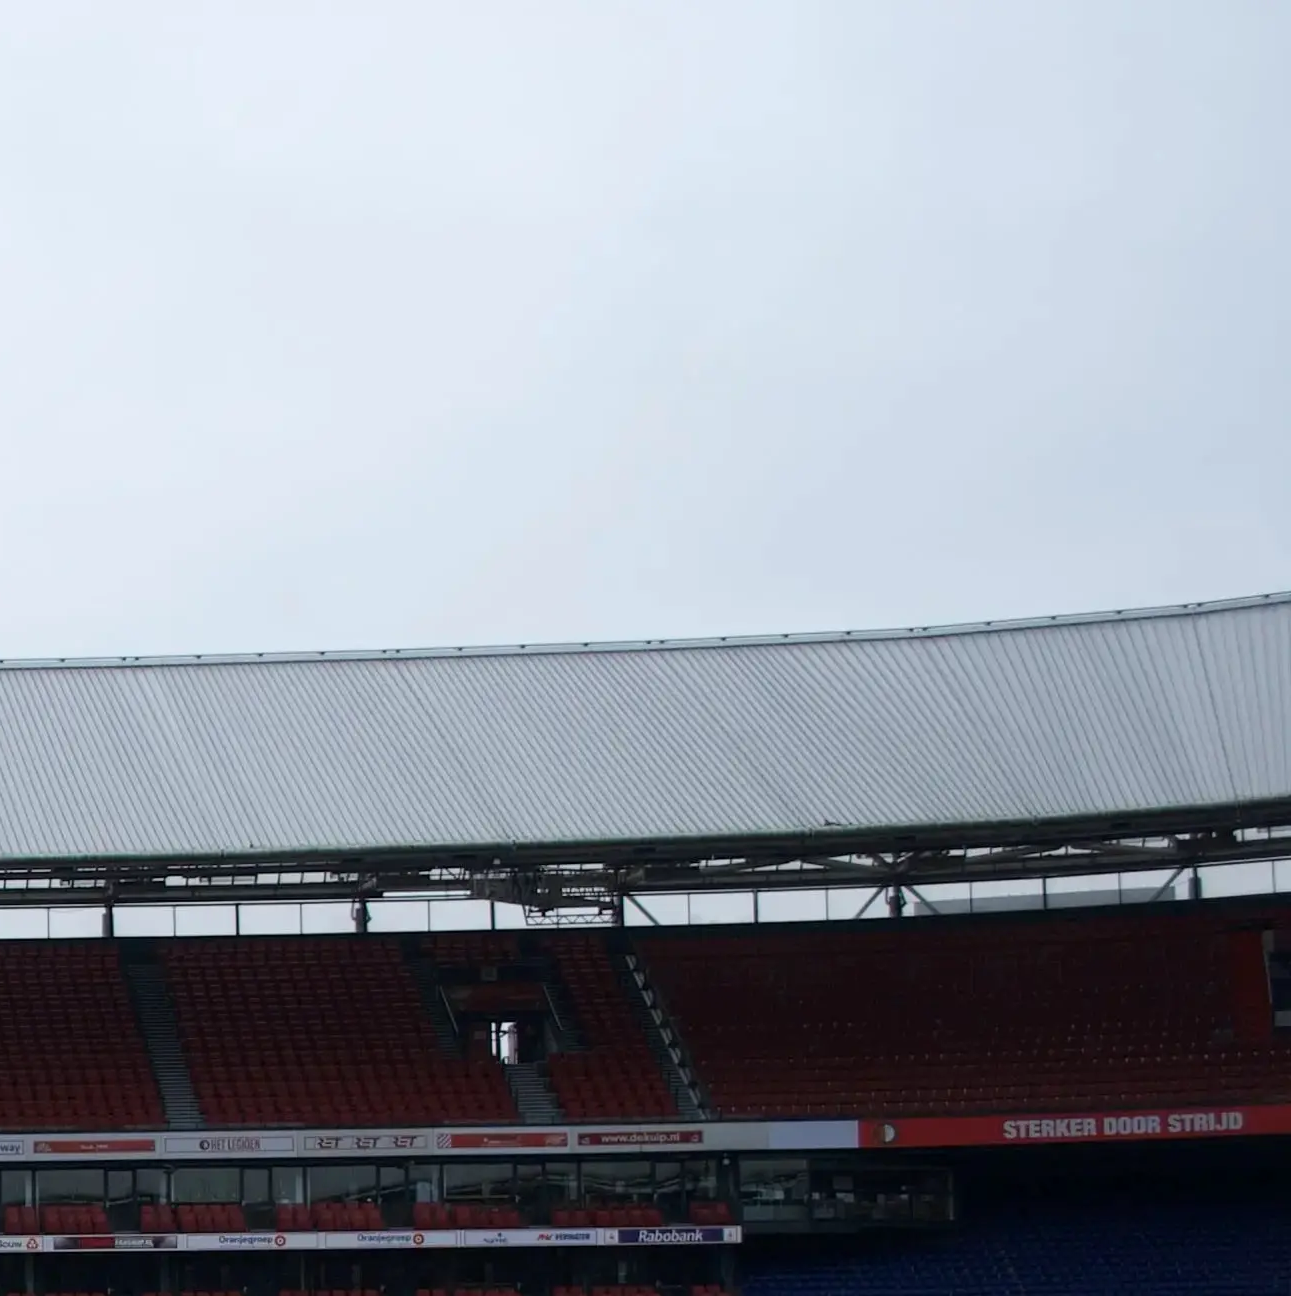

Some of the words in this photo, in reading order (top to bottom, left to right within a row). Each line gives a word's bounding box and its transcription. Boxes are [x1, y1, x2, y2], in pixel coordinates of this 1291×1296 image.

[1002, 1117, 1098, 1140] STERKER
[1103, 1115, 1161, 1136] DOOR
[1167, 1111, 1244, 1133] STRIJD
[317, 1136, 345, 1149] RET
[355, 1136, 382, 1149] RET
[600, 1132, 681, 1144] www.dekuip.nl
[638, 1229, 704, 1243] Rabobank
